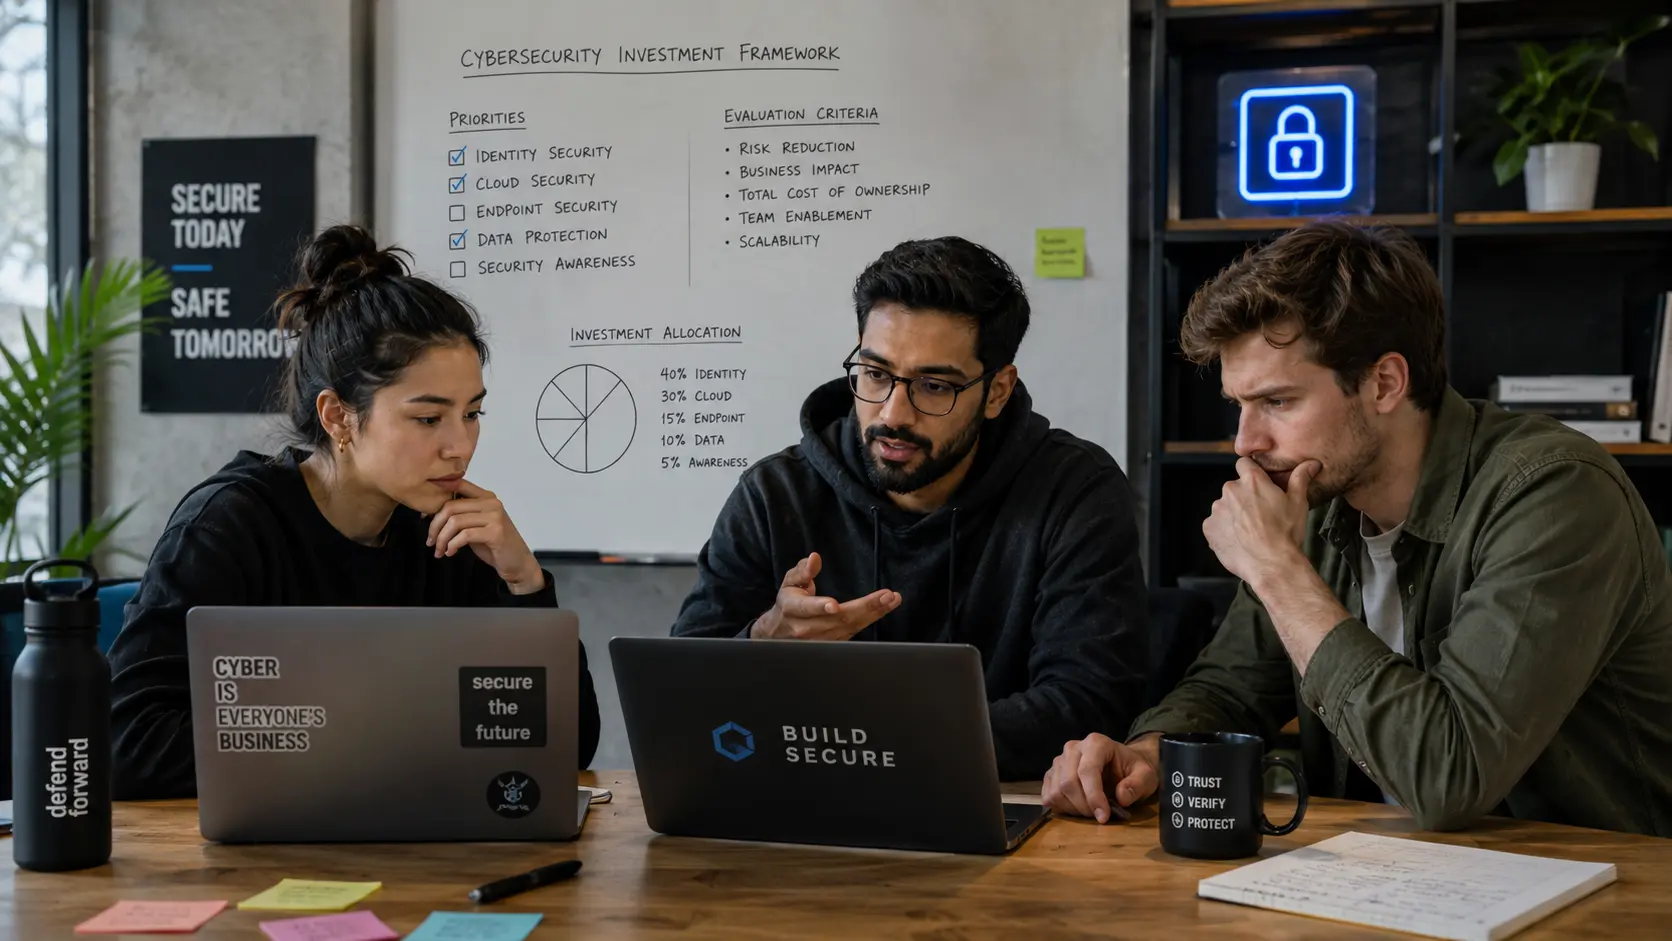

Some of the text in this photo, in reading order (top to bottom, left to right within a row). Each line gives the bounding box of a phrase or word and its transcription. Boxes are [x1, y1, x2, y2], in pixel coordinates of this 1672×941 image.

[460, 43, 841, 70] CYBERSECURITY INVESTMENT FRAMEWORK
[449, 111, 526, 128] PRIORITIES
[724, 106, 879, 124] EVALUATION CRITERIA
[476, 145, 613, 163] IDENTITY SECURITY
[739, 140, 855, 156] RISK REDUCTION
[739, 163, 860, 180] BUSINESS IMPACT
[475, 172, 596, 191] CLOUD SECURITY
[171, 183, 261, 214] SECURE
[737, 182, 931, 202] TOTAL COST OF OWNERSHIP
[476, 199, 618, 219] ENDPOINT SECURITY
[738, 208, 873, 225] TEAM ENABLEMENT
[171, 219, 245, 248] TODAY
[477, 227, 608, 248] DATA PROTECTION
[739, 234, 821, 249] SCALABILITY
[477, 254, 636, 275] SECURITY AWARENESS
[171, 287, 230, 318] SAFE
[570, 325, 742, 342] INVESTMENT ALLOCATION
[660, 367, 747, 382] 40% IDENTITY
[661, 389, 733, 403] 30% CLOUD
[661, 411, 746, 425] 15% ENDPOINT
[660, 433, 725, 447] 10% DATA
[661, 456, 749, 470] 5% AWARENESS
[214, 657, 279, 678] CYBER
[472, 675, 534, 690] secure
[215, 682, 236, 702] IS
[487, 699, 518, 716] the
[217, 707, 325, 728] EVERYONE'S
[218, 732, 309, 751] BUSINESS
[475, 724, 532, 741] future
[782, 725, 867, 744] BUILD
[785, 746, 896, 767] SECURE
[45, 746, 67, 819] defend
[68, 737, 89, 818] forward
[1187, 775, 1223, 789] TRUST
[1187, 796, 1226, 810] VERIFY
[1187, 816, 1236, 830] PROTECT
